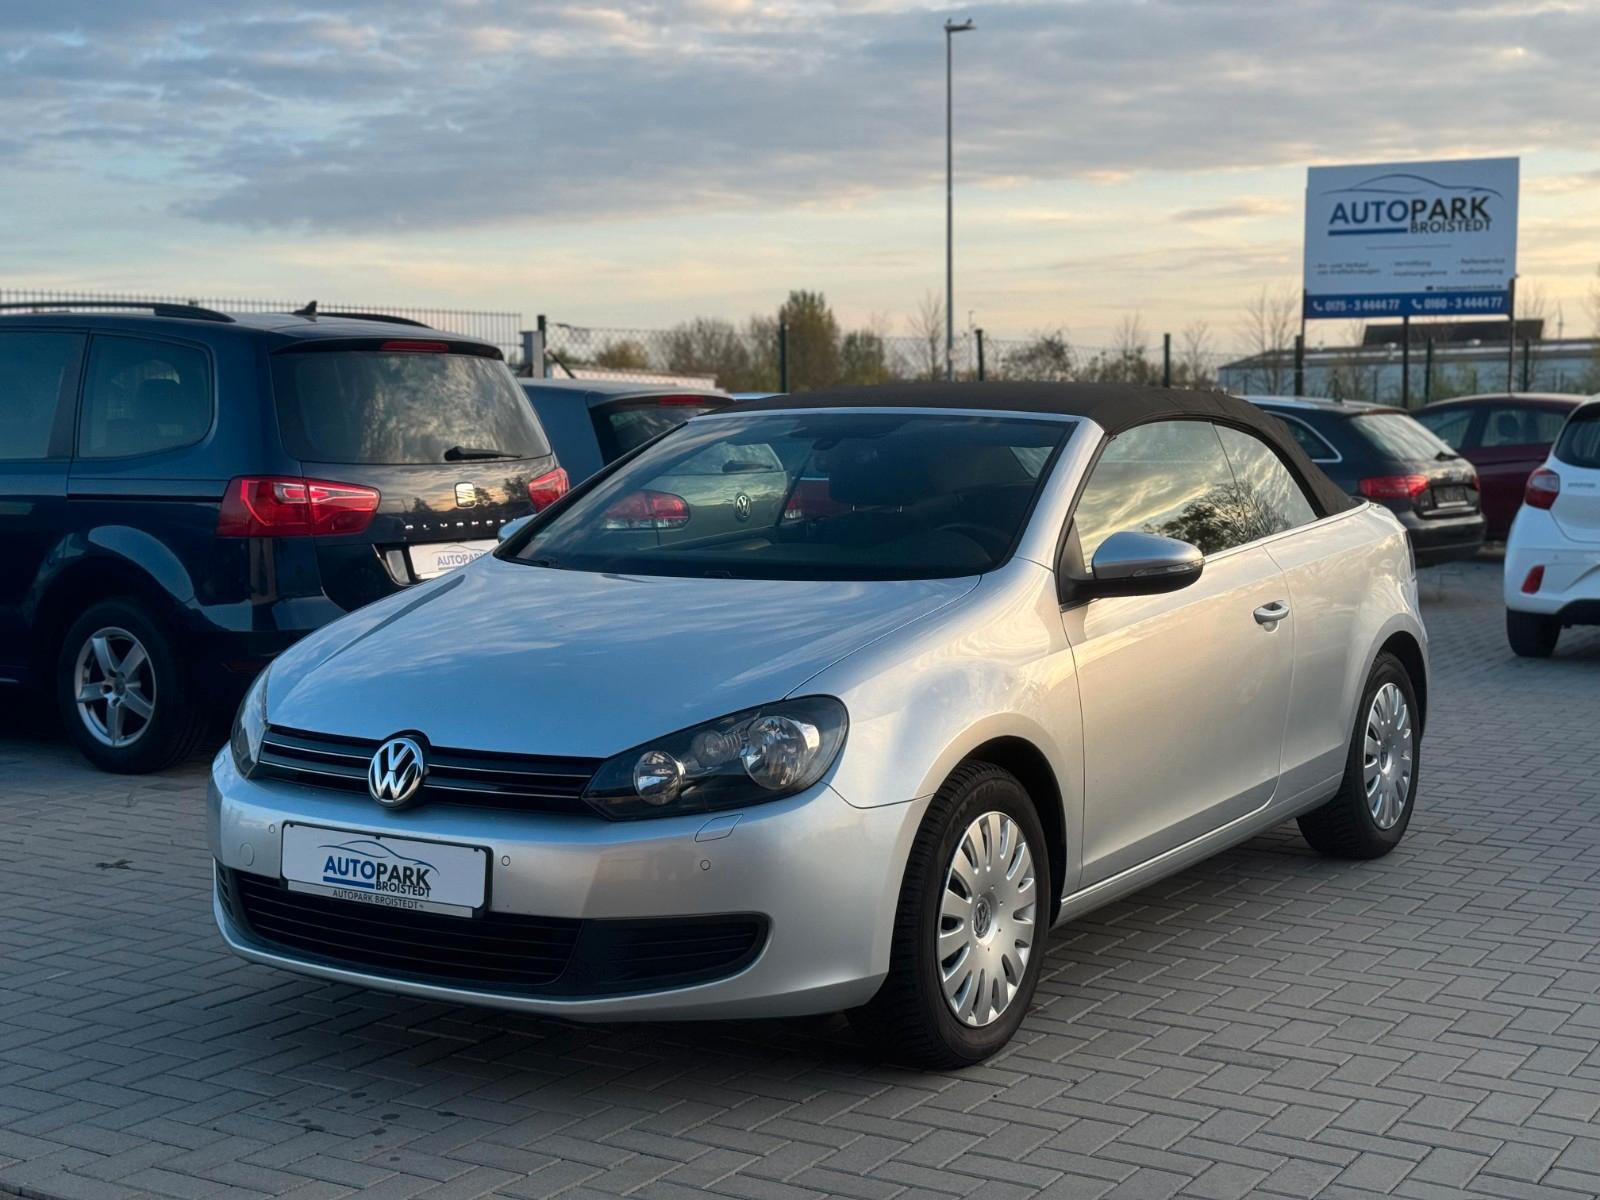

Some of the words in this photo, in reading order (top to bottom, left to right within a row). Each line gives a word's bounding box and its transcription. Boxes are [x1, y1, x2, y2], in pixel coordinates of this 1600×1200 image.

[1329, 196, 1491, 225] AUTOPARK
[1410, 217, 1492, 234] BROISTEDT
[437, 552, 483, 566] AUTOPA
[324, 855, 431, 888] AUTOPARK
[376, 880, 431, 898] BROISTEDT
[333, 890, 373, 902] AUTOPARK
[375, 896, 418, 909] BROISTEDT
